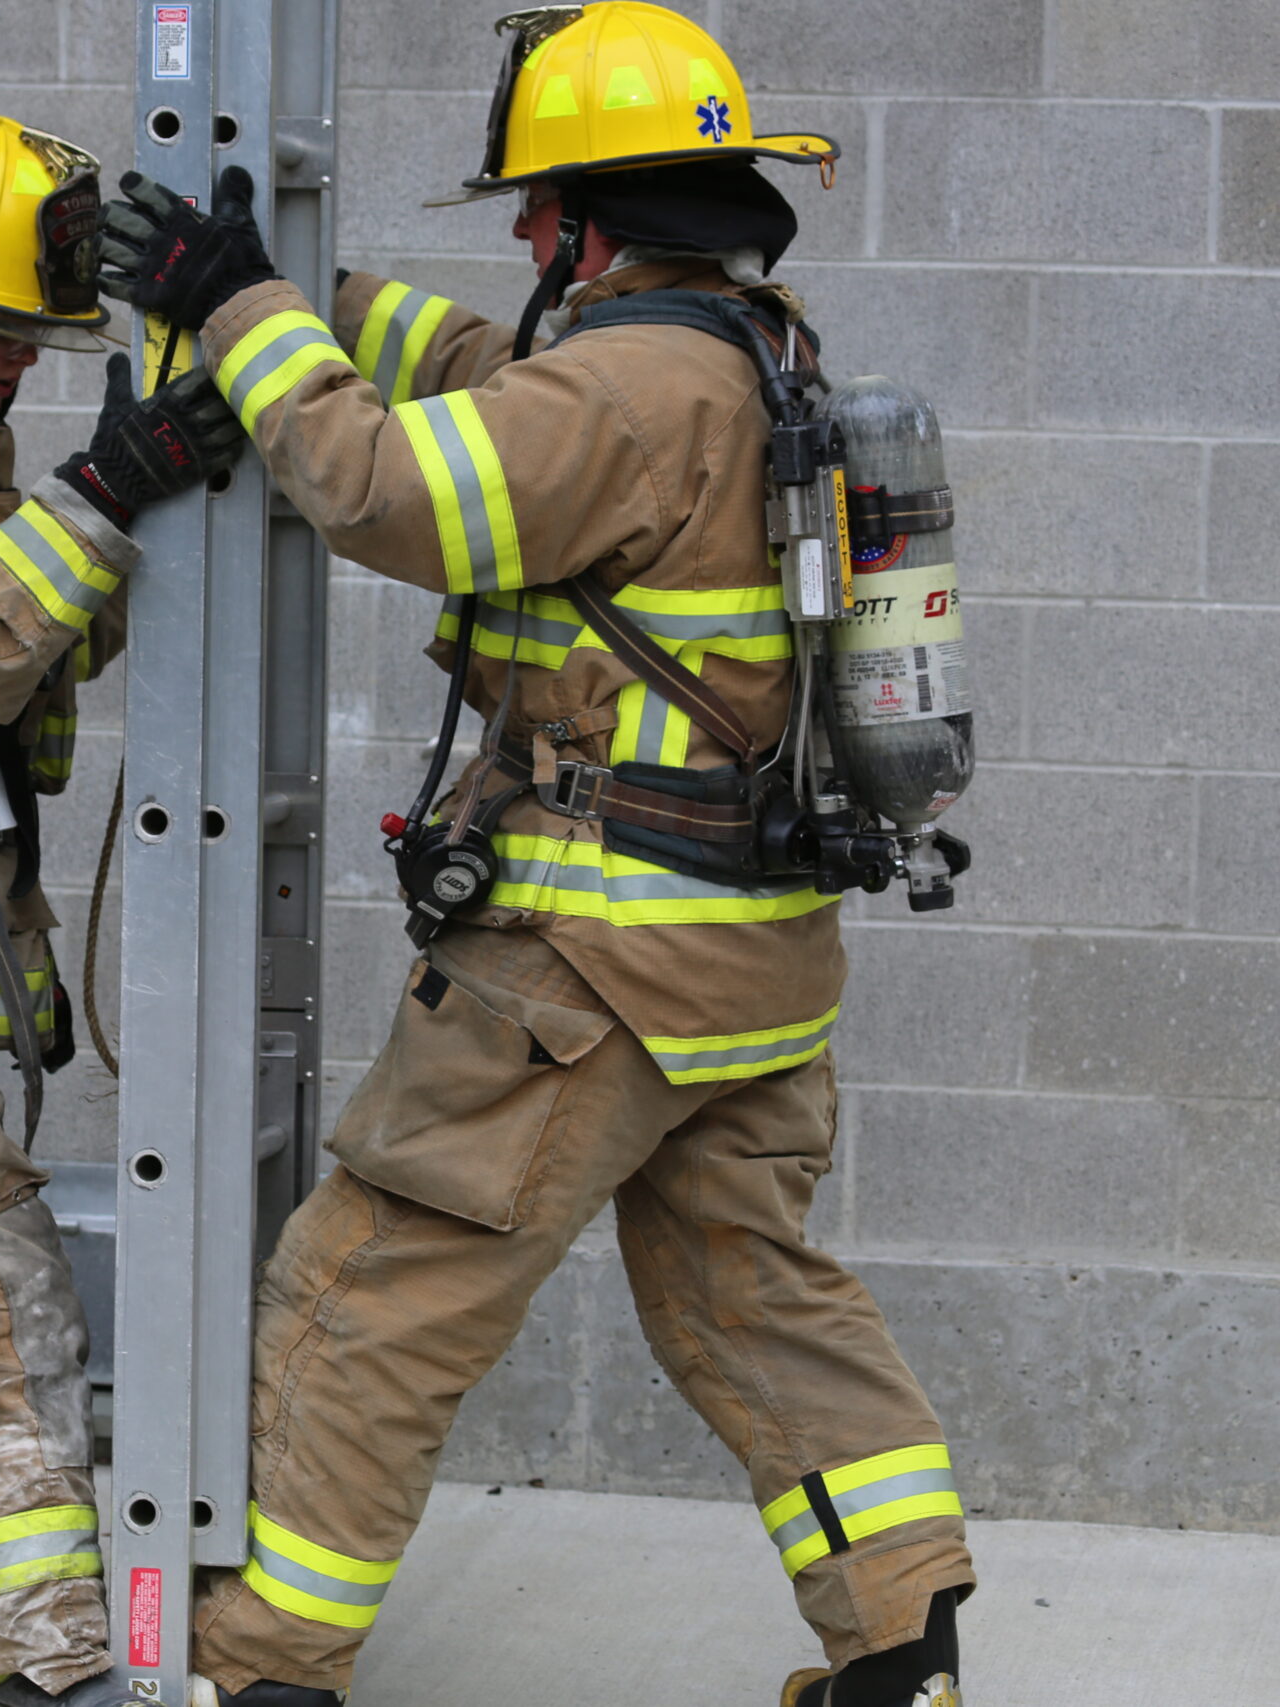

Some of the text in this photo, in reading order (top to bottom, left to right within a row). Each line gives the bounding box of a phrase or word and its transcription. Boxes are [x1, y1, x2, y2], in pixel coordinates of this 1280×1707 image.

[835, 482, 848, 566] SCOTT
[854, 596, 897, 617] OTT
[874, 697, 903, 706] Luxfer
[441, 875, 470, 893] SCOTT
